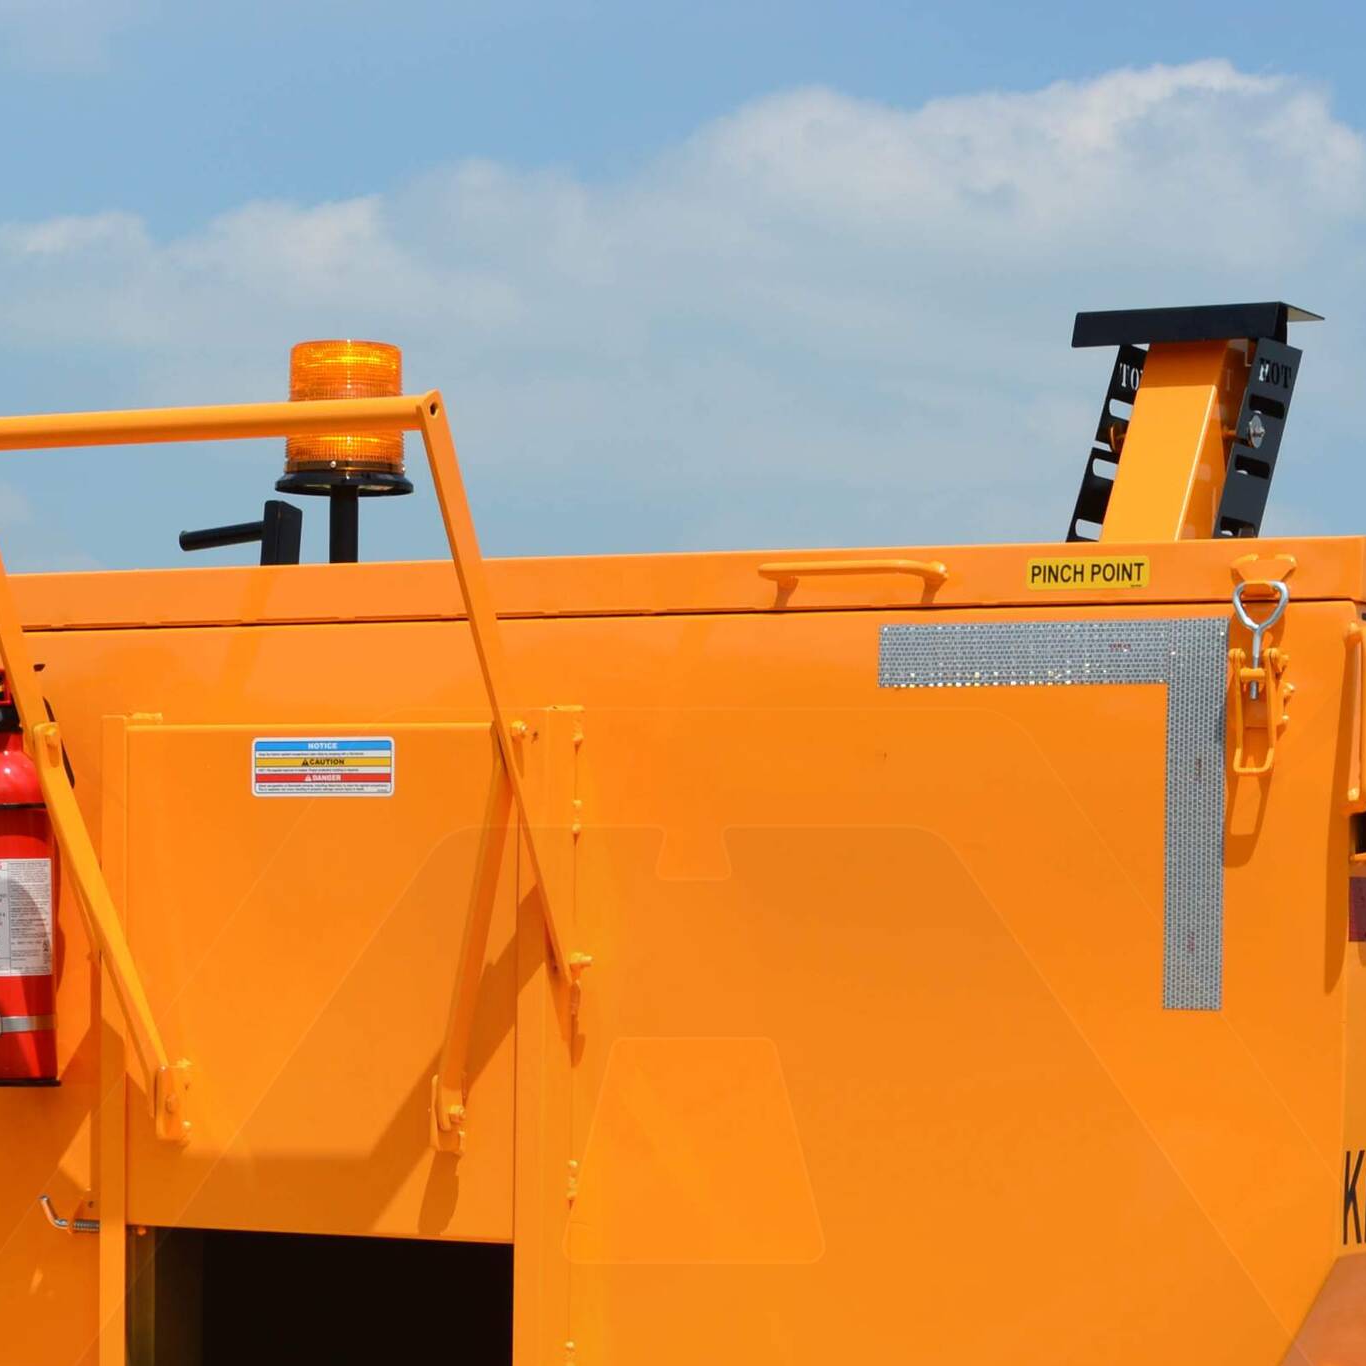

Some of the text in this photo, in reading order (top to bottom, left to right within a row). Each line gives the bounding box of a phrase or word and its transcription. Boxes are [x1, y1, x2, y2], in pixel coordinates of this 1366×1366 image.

[1258, 356, 1293, 389] HOT
[1030, 562, 1145, 584] PINCH POINT
[307, 742, 338, 750] NOTICE
[309, 758, 345, 766] CAUTION
[312, 774, 342, 782] DANGER
